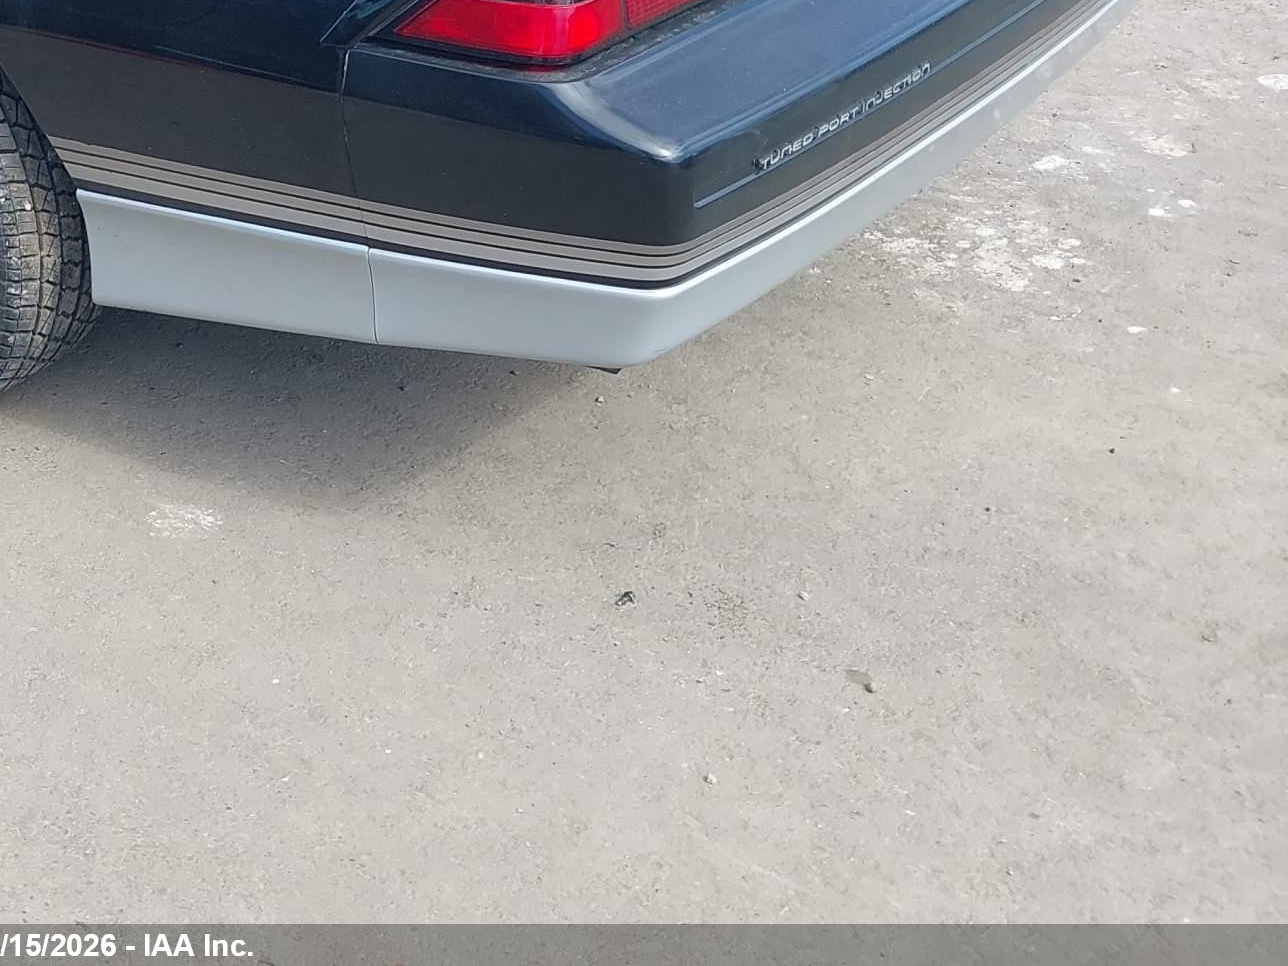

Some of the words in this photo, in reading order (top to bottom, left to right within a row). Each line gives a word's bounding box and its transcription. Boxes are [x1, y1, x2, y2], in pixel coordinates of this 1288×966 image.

[758, 132, 814, 170] TUNED
[817, 106, 860, 138] PORT
[861, 62, 931, 113] INJECTION
